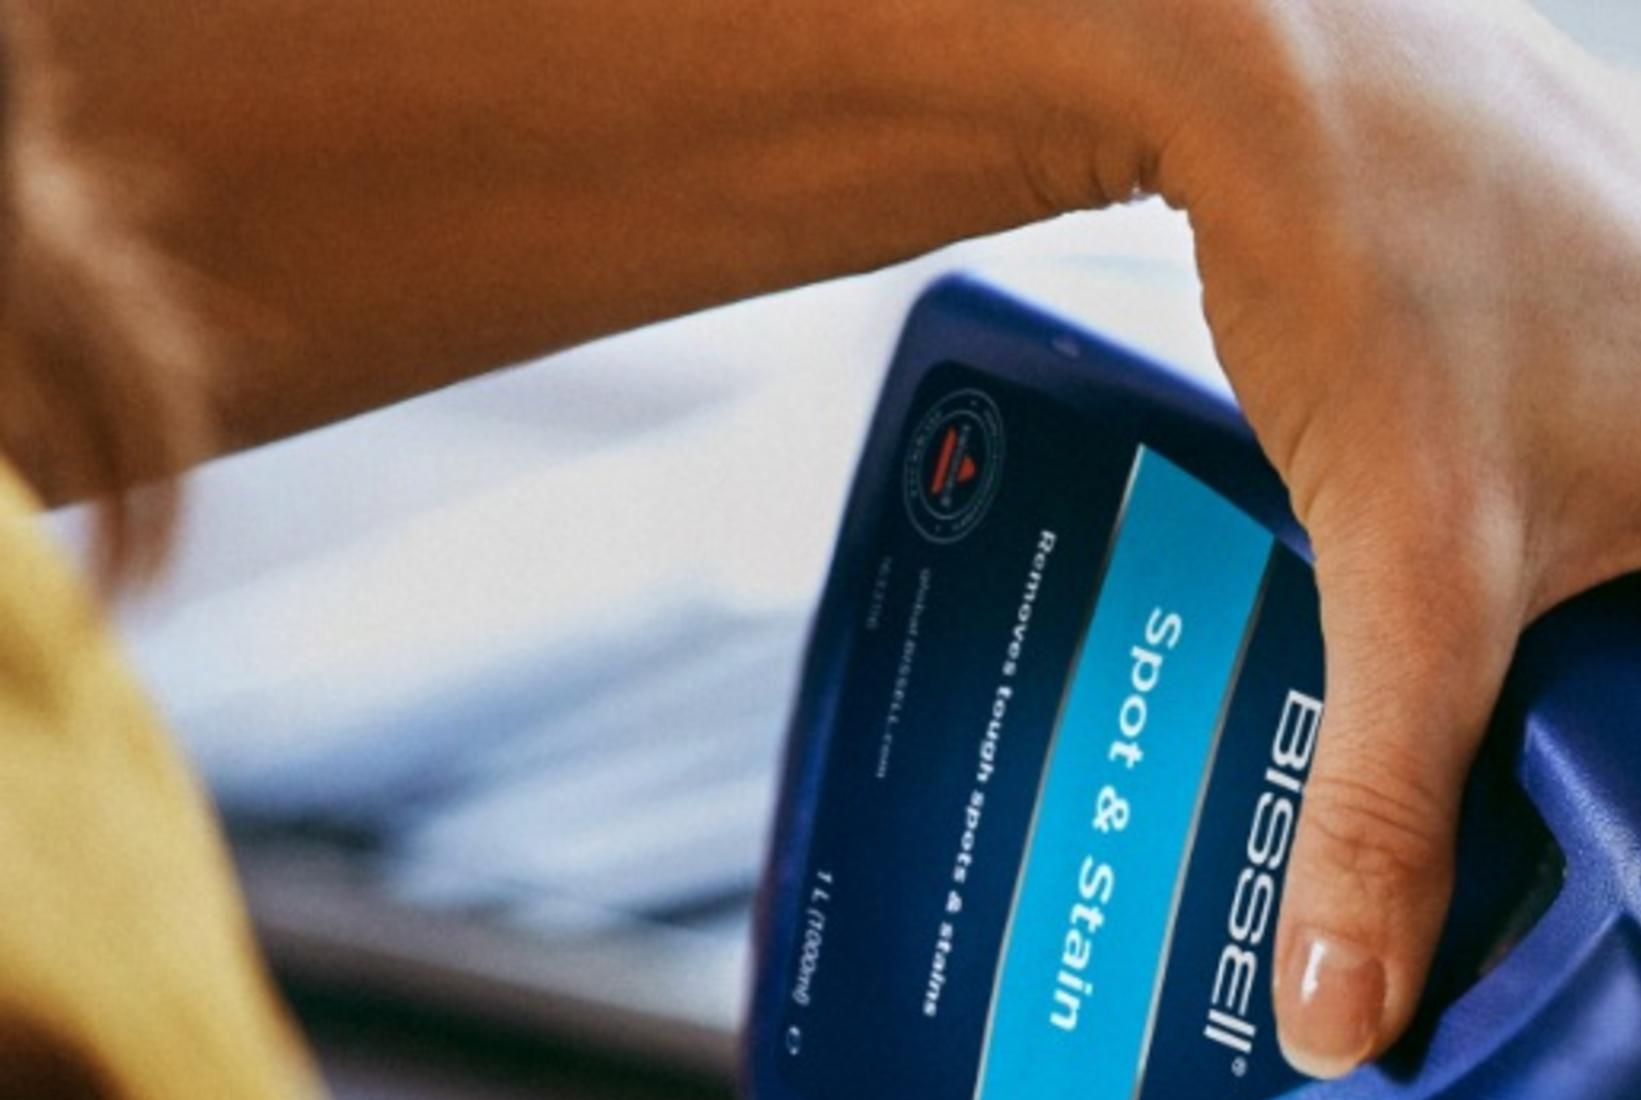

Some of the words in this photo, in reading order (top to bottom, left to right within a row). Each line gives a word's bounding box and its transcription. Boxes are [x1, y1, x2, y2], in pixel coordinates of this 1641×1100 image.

[1002, 529, 1057, 677] Removes
[976, 686, 1013, 783] tough
[1109, 607, 1183, 769] Spot
[953, 791, 985, 886] spots
[1092, 785, 1132, 833] &
[945, 890, 963, 914] &
[1049, 855, 1116, 1032] Stain
[922, 921, 954, 1018] stains
